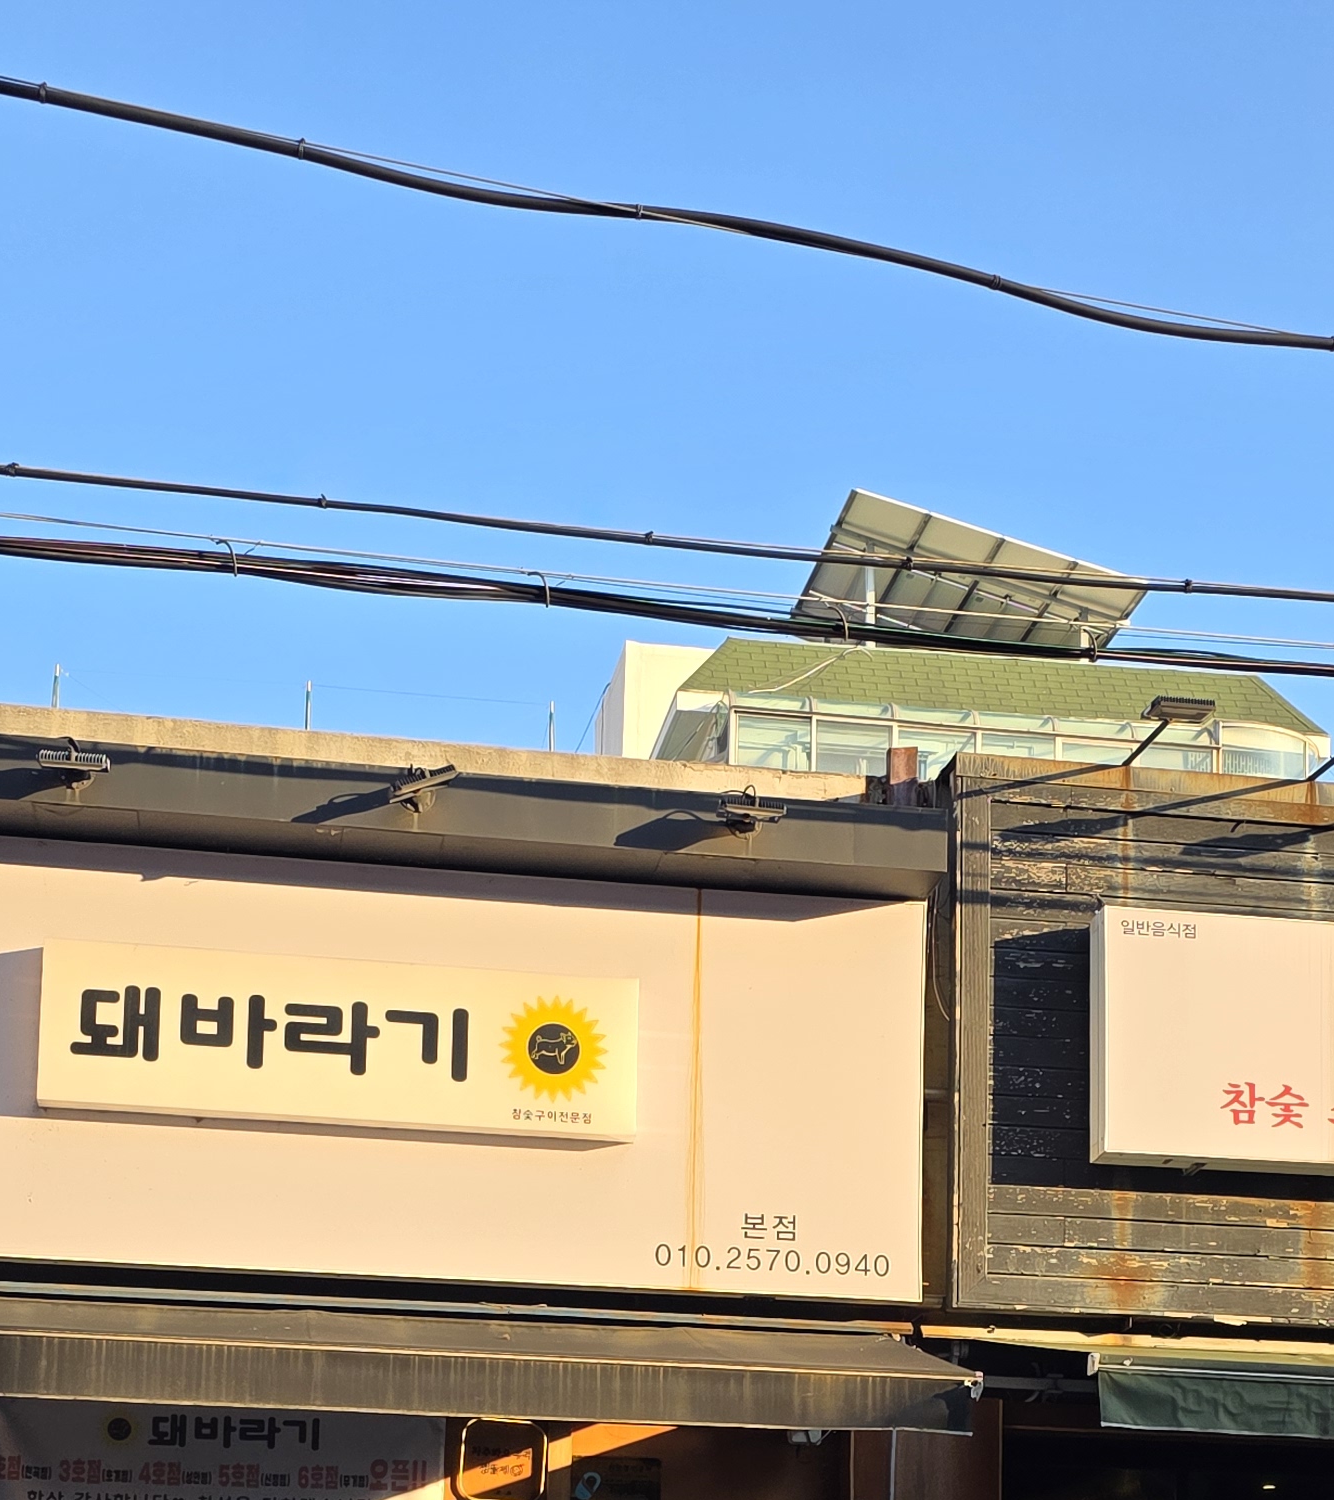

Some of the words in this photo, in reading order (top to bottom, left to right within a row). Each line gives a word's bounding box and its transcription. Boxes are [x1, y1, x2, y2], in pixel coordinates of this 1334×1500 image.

[1120, 918, 1198, 941] 일반음식점
[69, 985, 469, 1083] 돼바라기
[511, 1107, 593, 1125] 참숯구이전문점
[1221, 1080, 1310, 1130] 참숯
[740, 1212, 798, 1243] 본점
[654, 1243, 892, 1279] 010.2570.0940
[148, 1413, 320, 1451] 돼바라기
